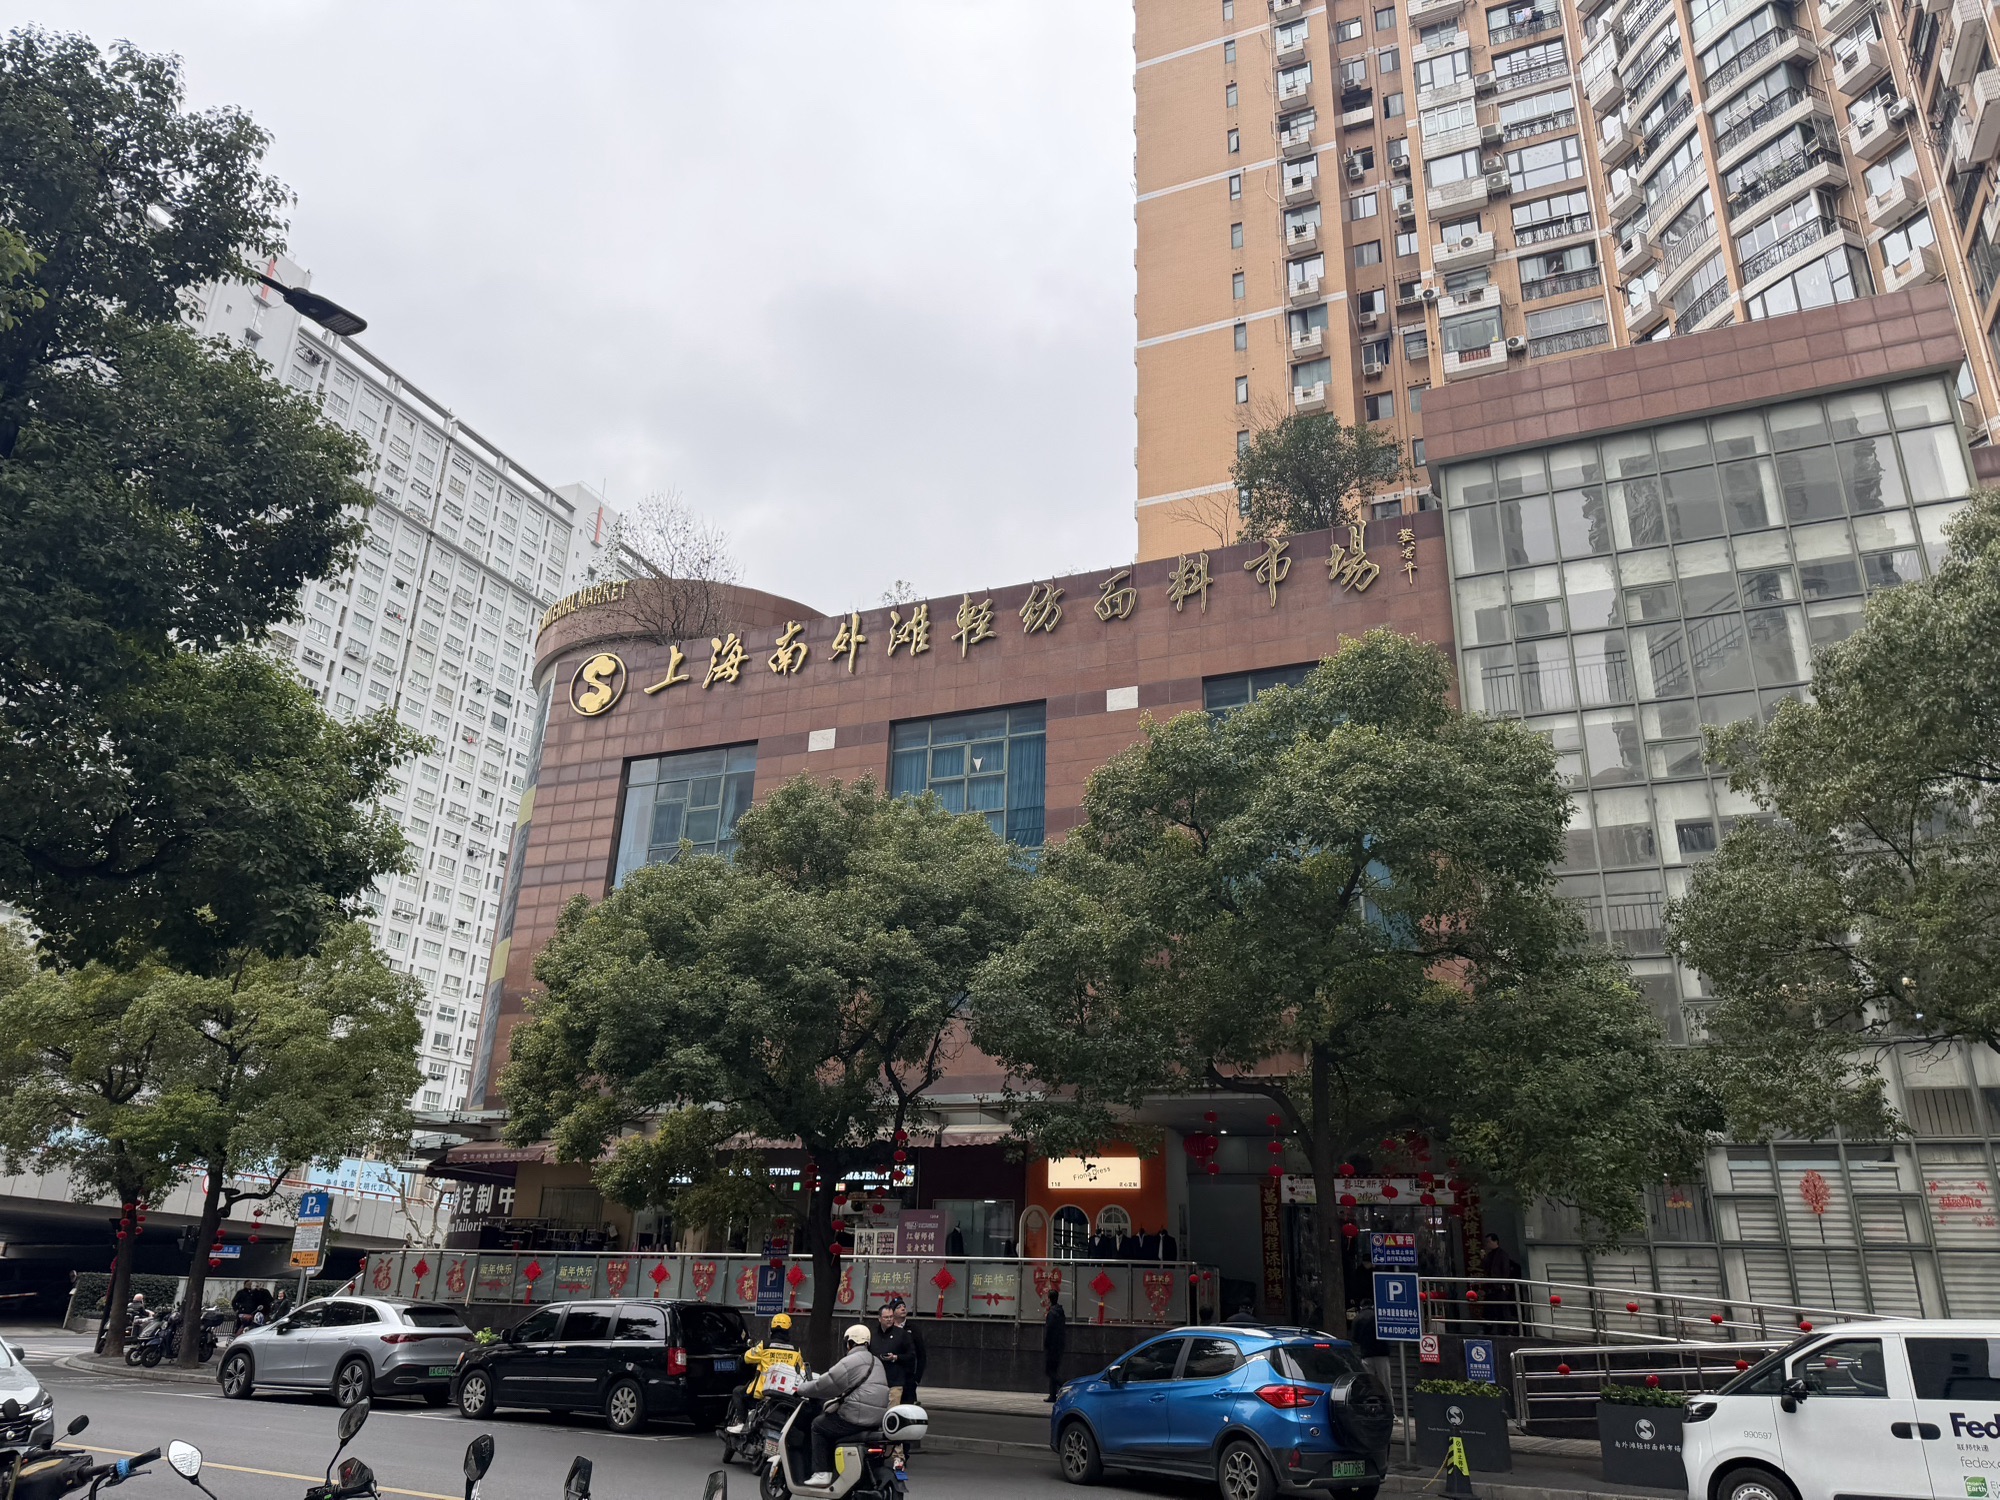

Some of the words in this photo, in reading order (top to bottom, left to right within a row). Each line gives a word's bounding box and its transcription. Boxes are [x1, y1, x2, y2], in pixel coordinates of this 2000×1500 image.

[578, 579, 628, 608] MARKET
[1073, 1170, 1092, 1181] Fiona
[1092, 1166, 1111, 1175] Dress
[305, 1196, 317, 1214] P
[1396, 1235, 1414, 1245] 警告
[480, 1263, 512, 1275] 新年快乐
[559, 1265, 593, 1277] 新年快乐
[871, 1271, 912, 1285] 新年快乐
[972, 1273, 1015, 1287] 新年快乐
[1389, 1281, 1403, 1301] P
[1743, 1430, 1773, 1440] 990597
